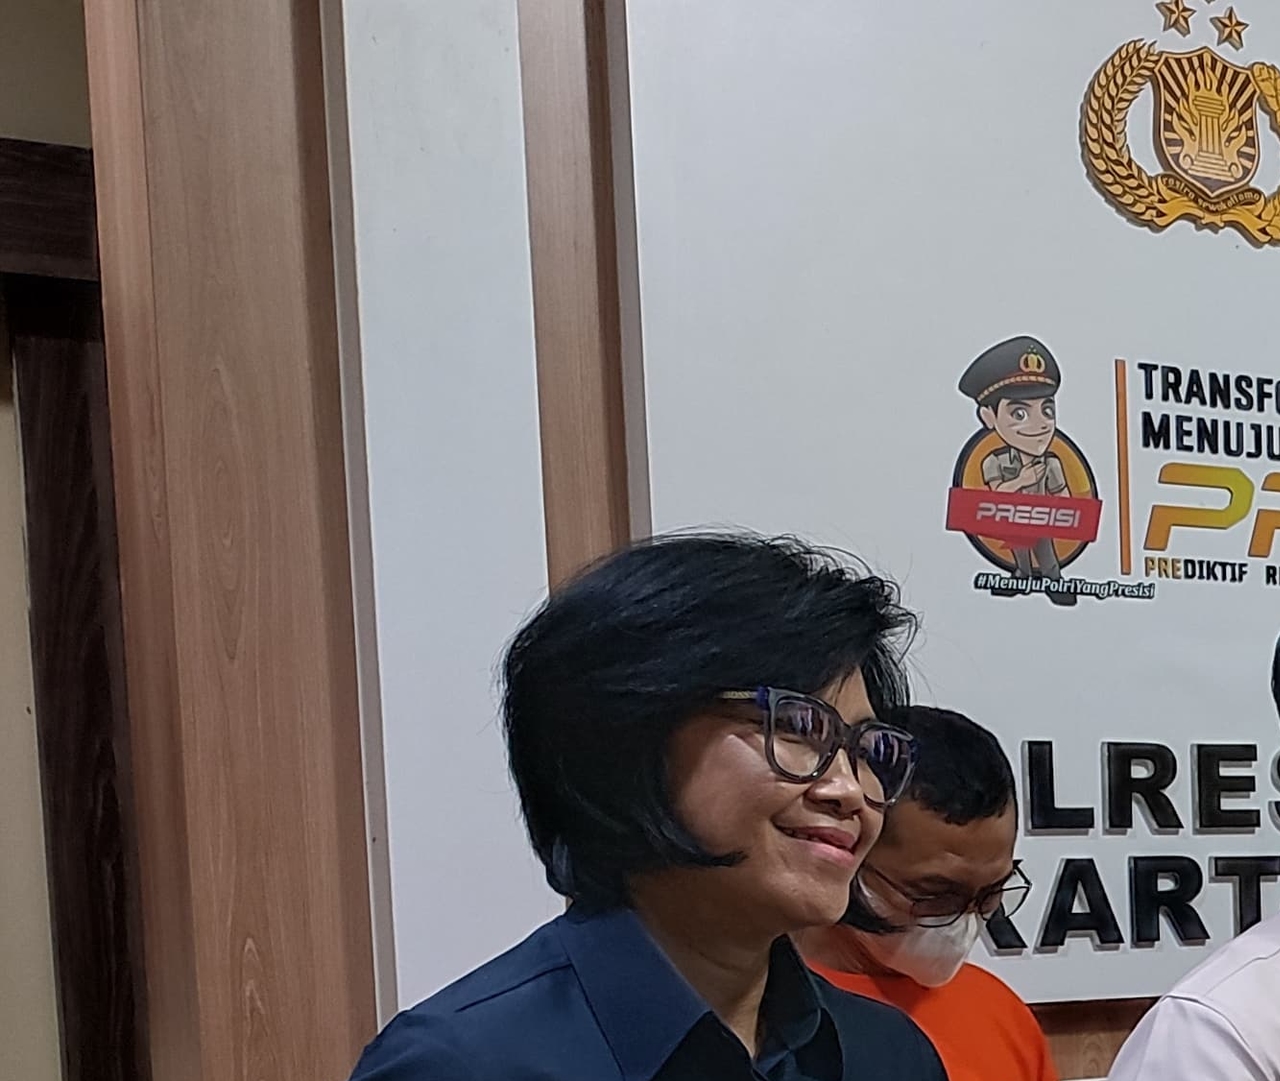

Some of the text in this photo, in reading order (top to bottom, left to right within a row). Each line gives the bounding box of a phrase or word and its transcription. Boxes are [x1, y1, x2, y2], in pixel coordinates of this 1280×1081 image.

[976, 502, 1082, 528] PRESISI
[1144, 556, 1249, 583] PREDIKTIF
[975, 573, 1156, 600] #MenujuPolriYangPresisi
